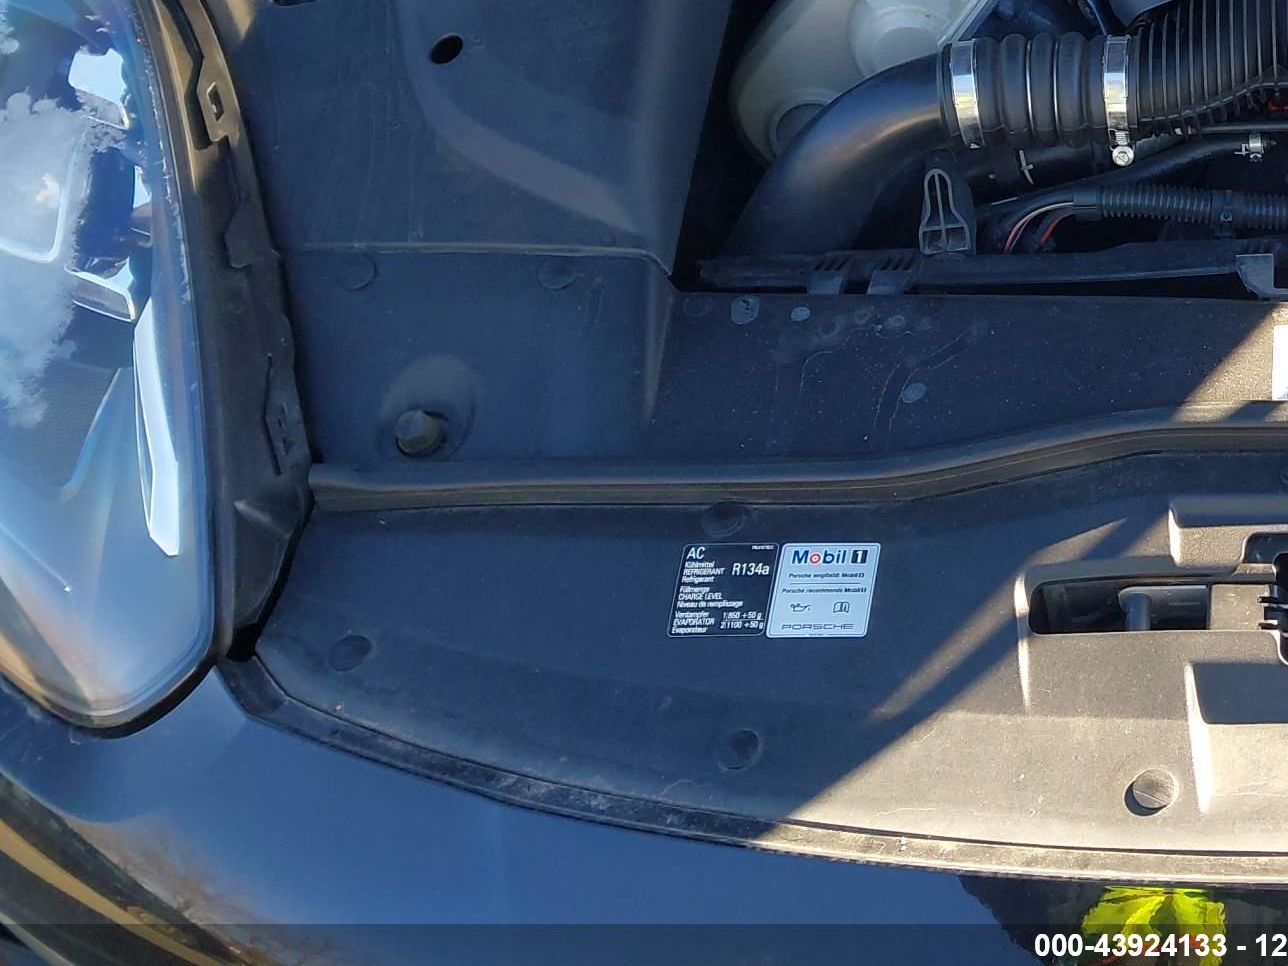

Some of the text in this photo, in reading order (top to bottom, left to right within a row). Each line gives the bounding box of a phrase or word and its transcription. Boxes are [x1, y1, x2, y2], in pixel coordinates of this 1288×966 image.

[686, 546, 706, 560] AC
[792, 550, 848, 564] Mobil
[683, 568, 725, 576] REFRIGERANT
[731, 562, 770, 576] R134a
[678, 592, 723, 601] CHARGE LEVEL
[674, 618, 715, 626] EVAPORATOR
